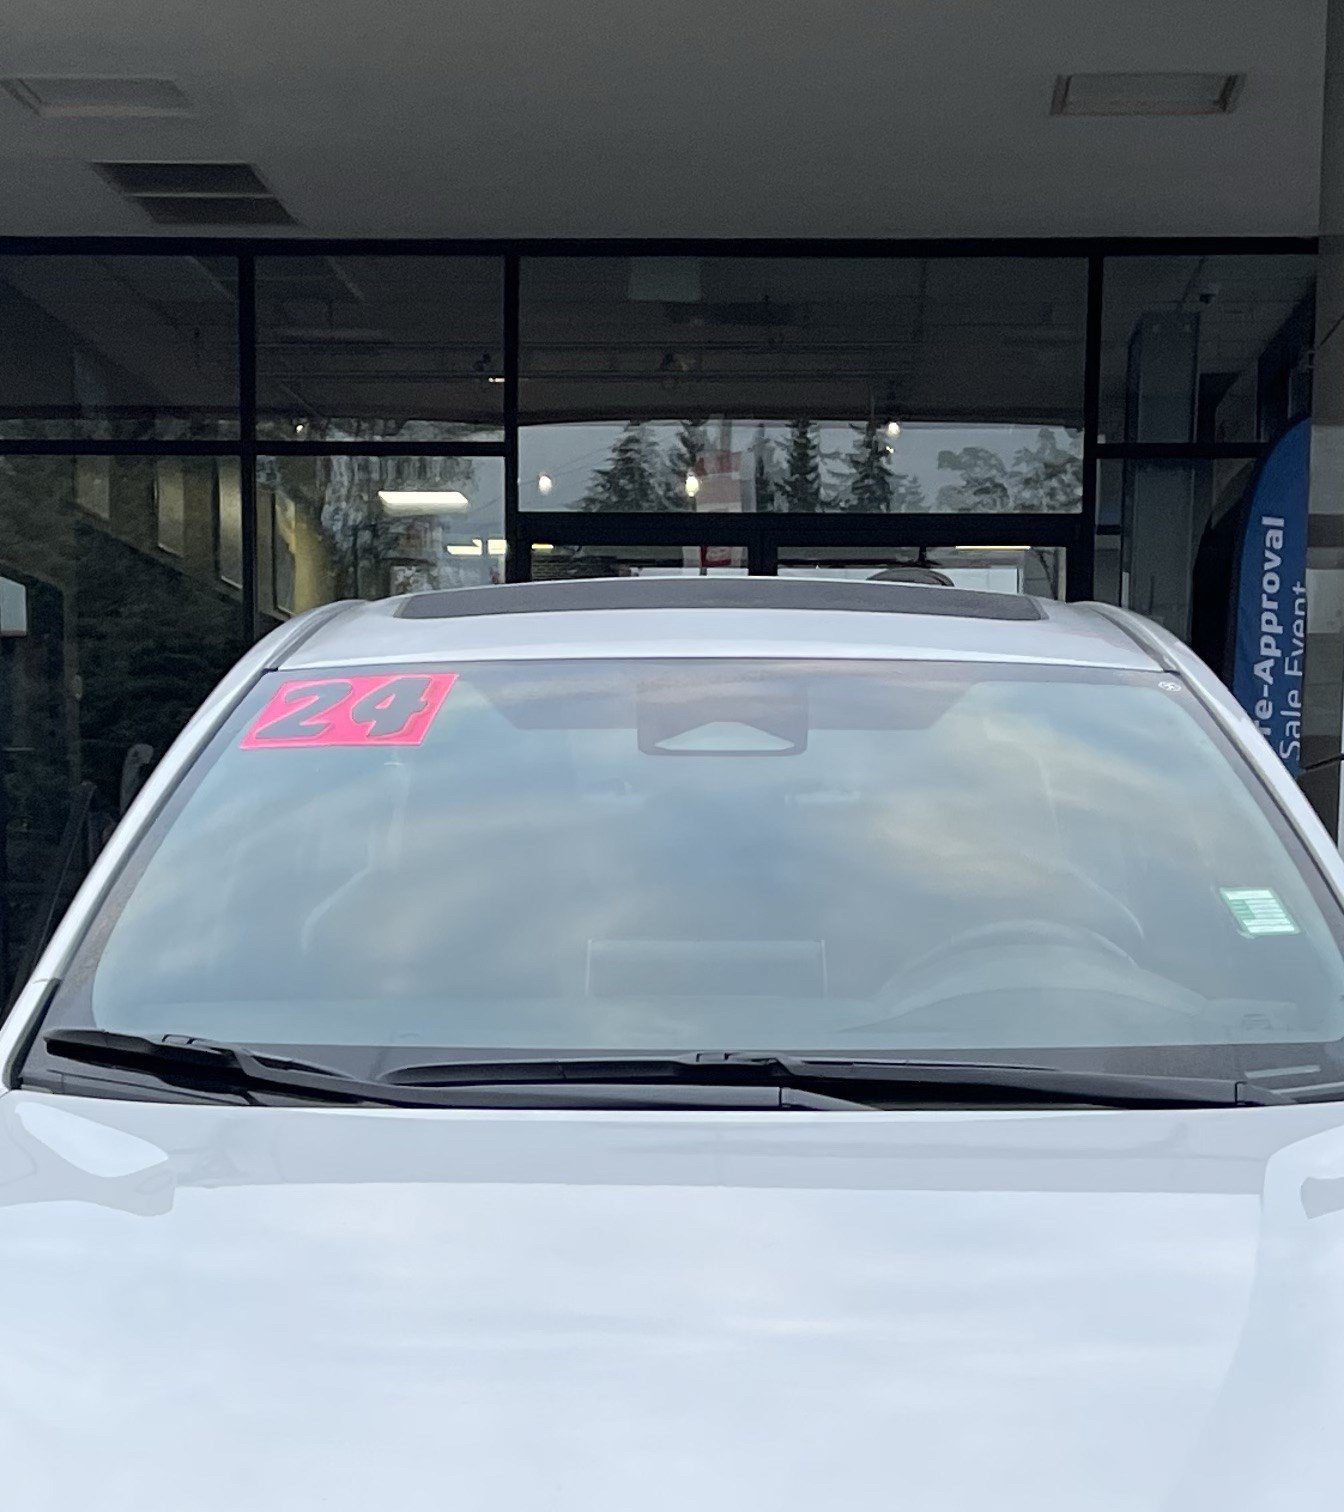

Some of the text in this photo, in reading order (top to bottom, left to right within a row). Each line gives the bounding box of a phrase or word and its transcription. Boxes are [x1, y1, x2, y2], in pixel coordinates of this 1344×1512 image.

[1253, 515, 1285, 738] re-Approval
[255, 675, 433, 739] 24
[1278, 689, 1302, 761] Sale
